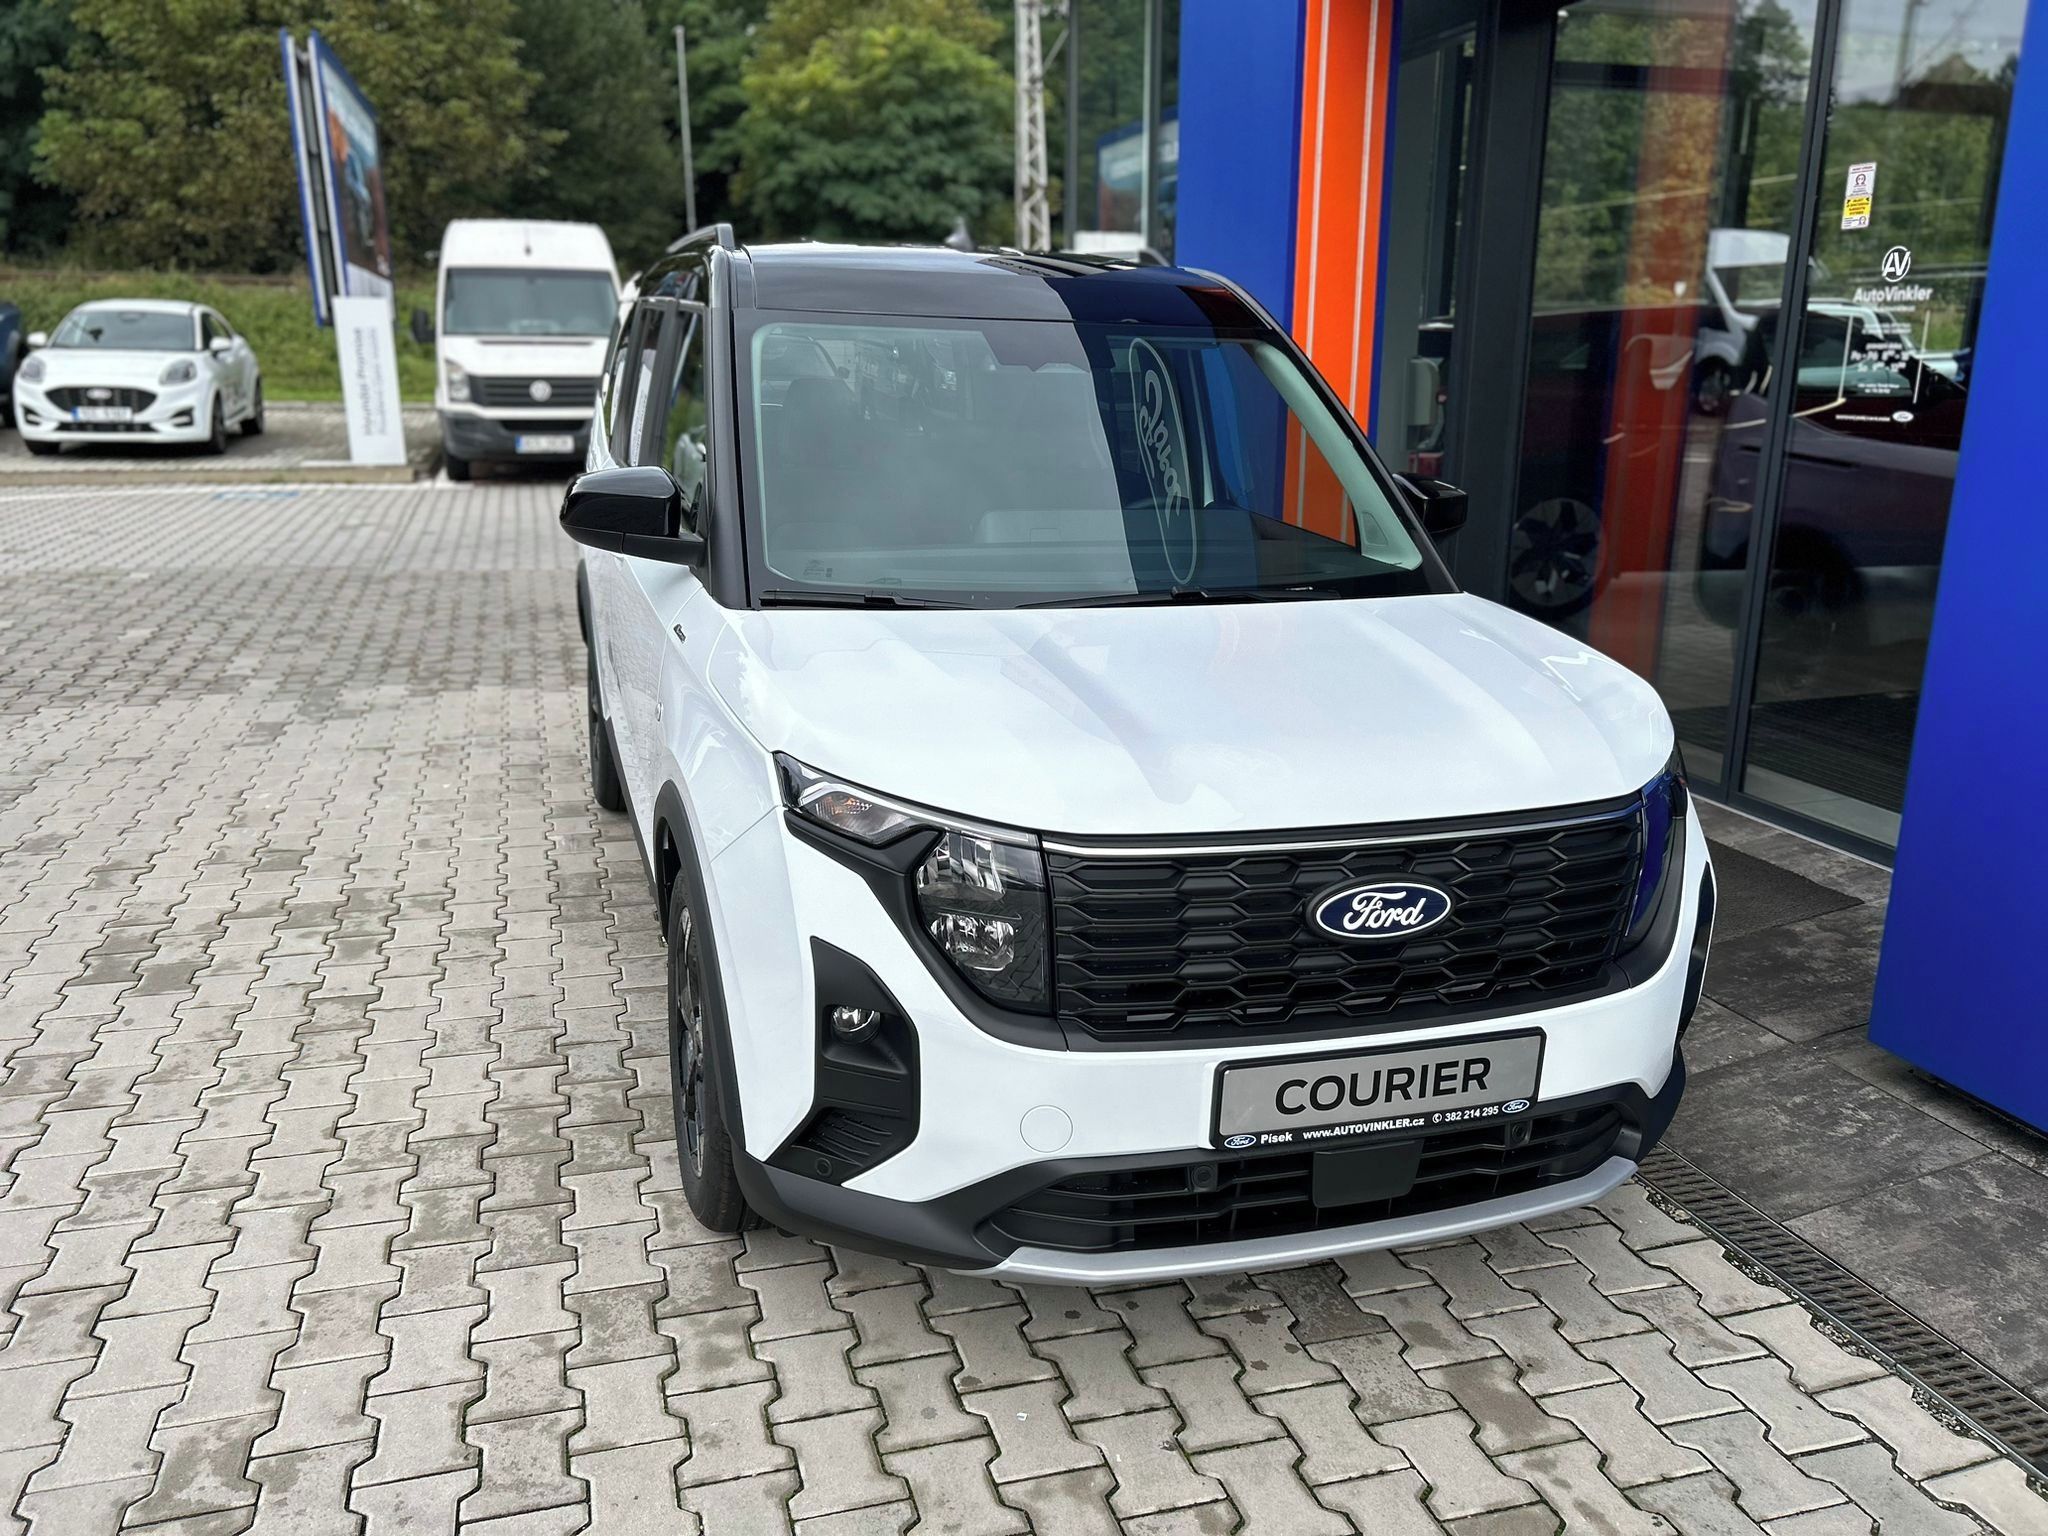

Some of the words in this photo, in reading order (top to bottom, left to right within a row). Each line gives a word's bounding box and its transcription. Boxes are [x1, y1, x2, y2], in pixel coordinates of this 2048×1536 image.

[1882, 251, 1911, 277] AV
[1853, 284, 1933, 303] AutoVinkler
[1342, 891, 1427, 930] Ford
[1275, 1057, 1491, 1115] COURIER
[1229, 1135, 1253, 1147] Ford
[1260, 1131, 1293, 1144] Písek
[1303, 1116, 1425, 1140] www.AUTOVINKLER.cz
[1445, 1112, 1462, 1122] 382
[1464, 1109, 1480, 1120] 214
[1481, 1105, 1499, 1117] 295
[1505, 1100, 1526, 1113] Ford
